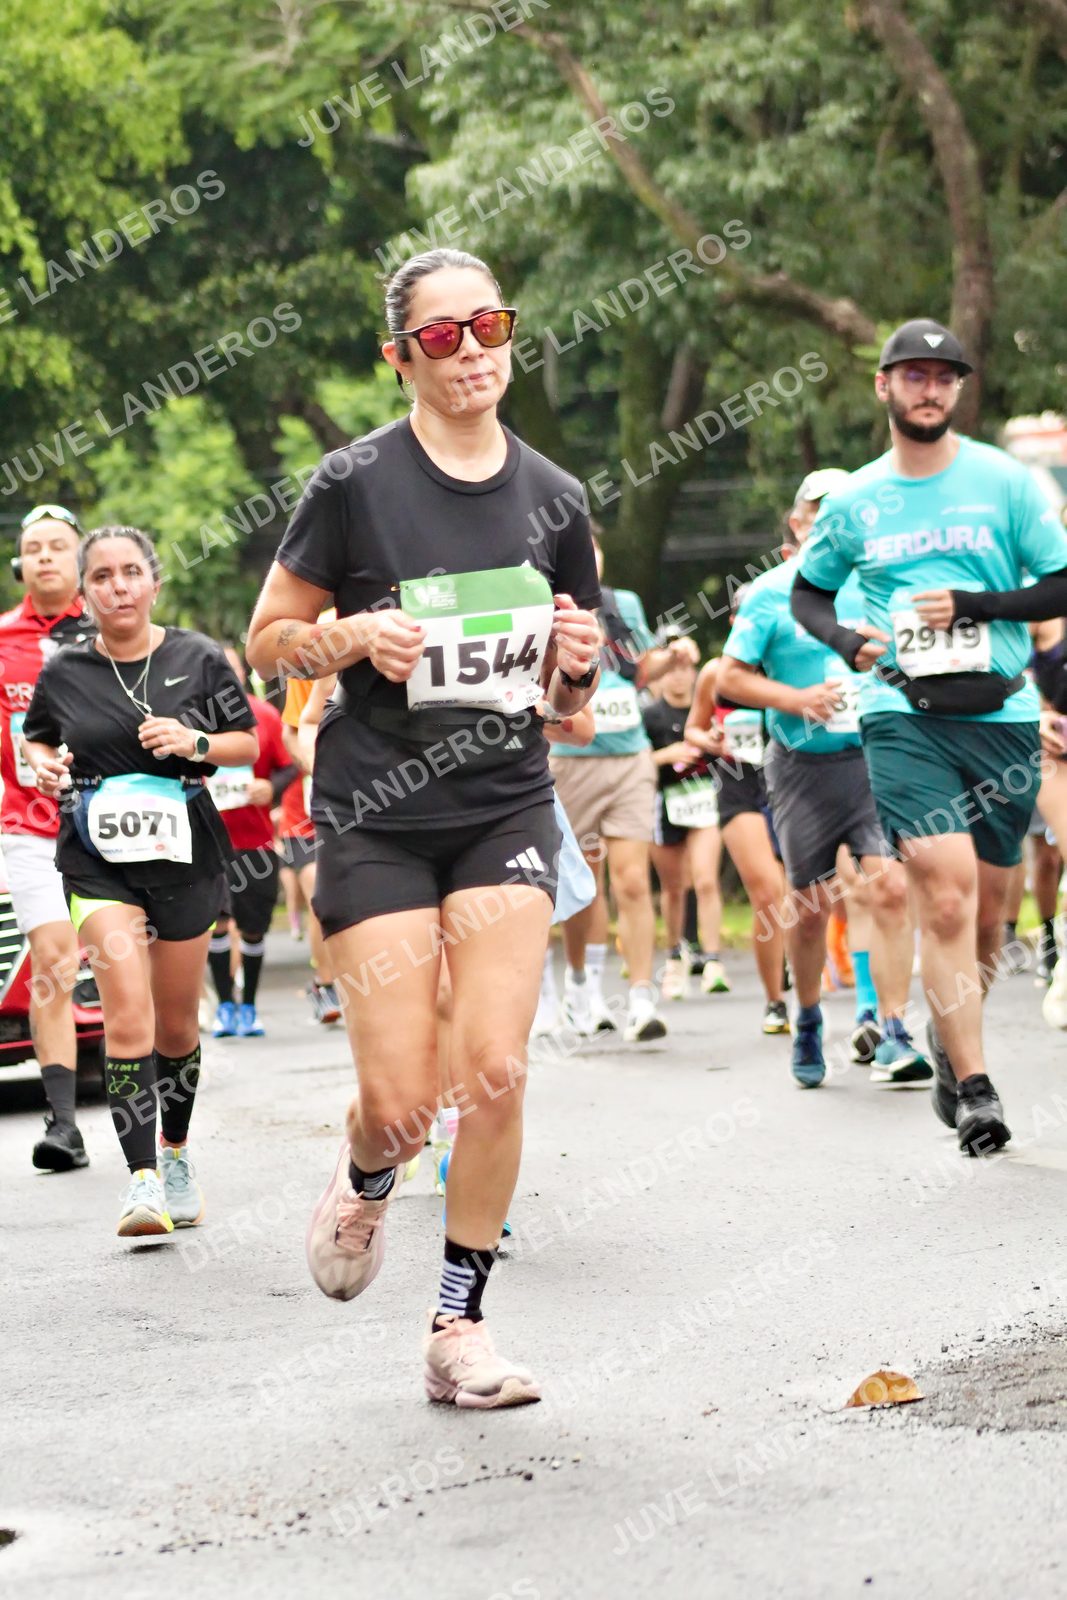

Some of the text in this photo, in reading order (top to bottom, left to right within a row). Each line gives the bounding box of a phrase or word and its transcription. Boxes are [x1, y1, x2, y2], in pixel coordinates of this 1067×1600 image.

[864, 525, 994, 561] PERDURA
[897, 622, 981, 655] 2919
[422, 633, 539, 688] 1544
[98, 810, 178, 840] 5071
[107, 1062, 141, 1072] KIME
